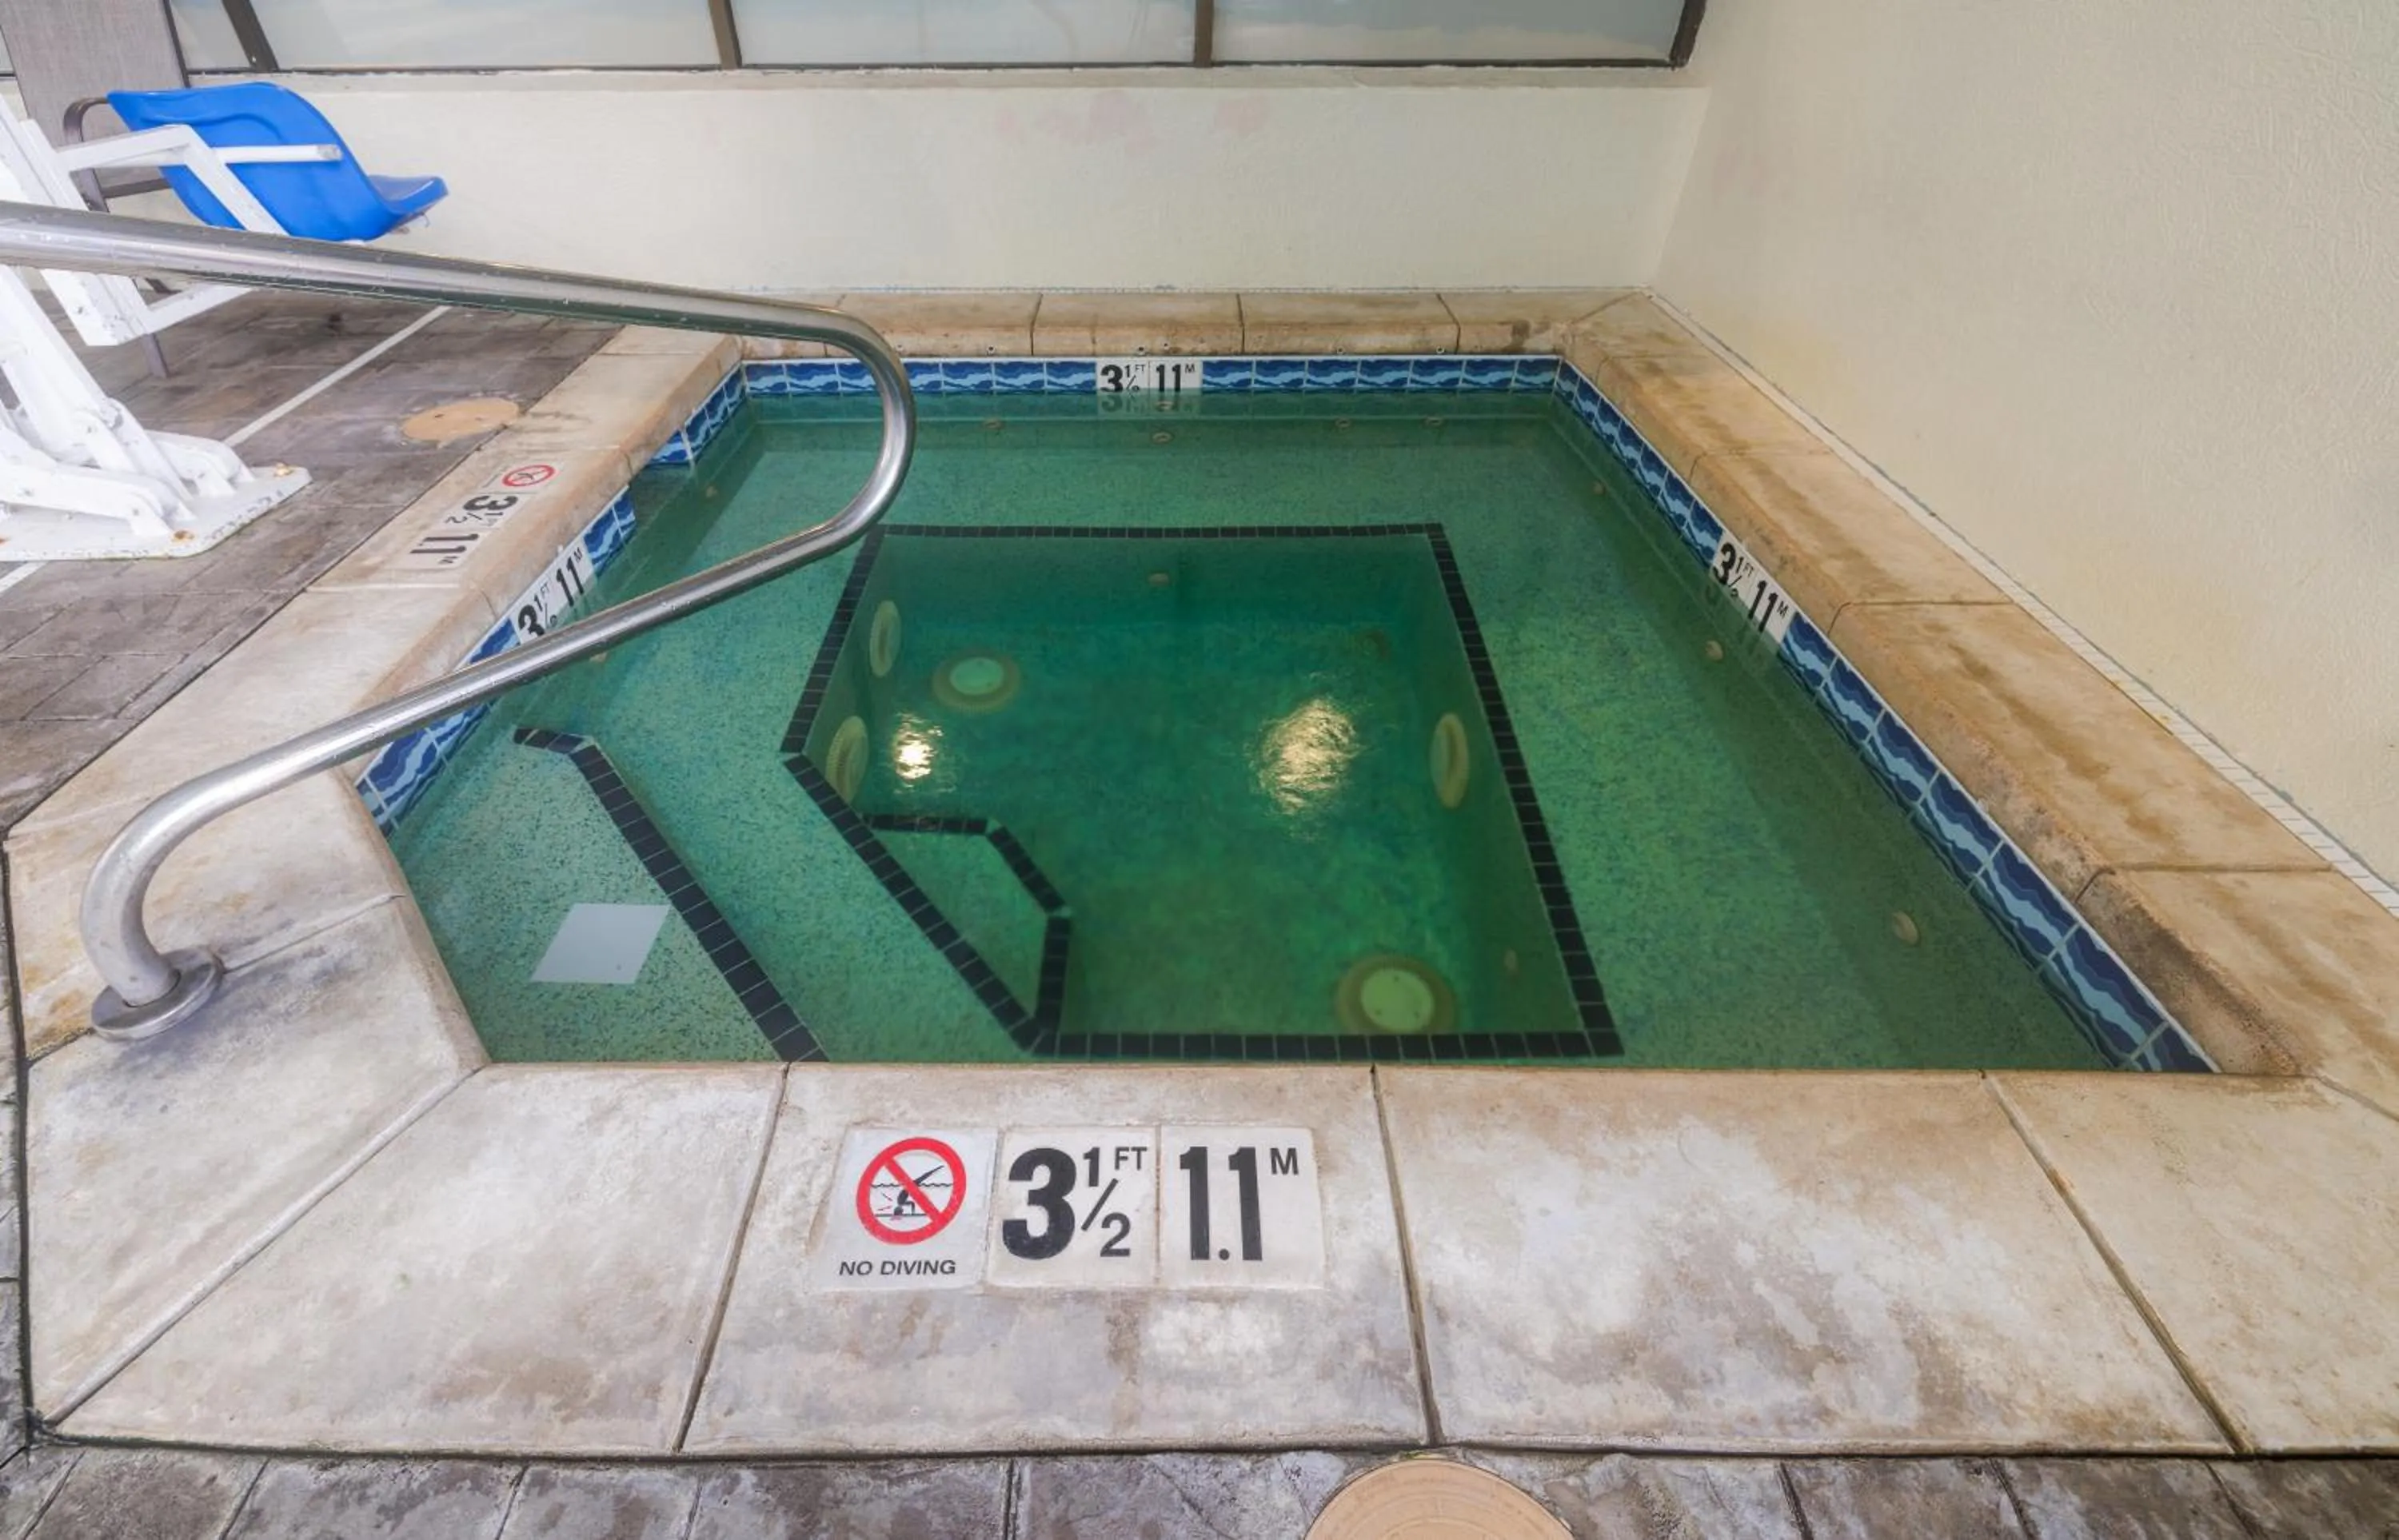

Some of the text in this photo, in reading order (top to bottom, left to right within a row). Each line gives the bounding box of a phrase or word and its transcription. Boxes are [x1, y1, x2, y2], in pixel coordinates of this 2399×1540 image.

[1100, 364, 1123, 393] 3
[1185, 364, 1196, 373] M
[1713, 542, 1736, 585] 3
[1002, 1147, 1076, 1260] 3
[1115, 1147, 1148, 1171] FT
[1180, 1147, 1263, 1261] 1.1
[1270, 1147, 1299, 1175] M
[840, 1259, 956, 1275] NO DIVING
